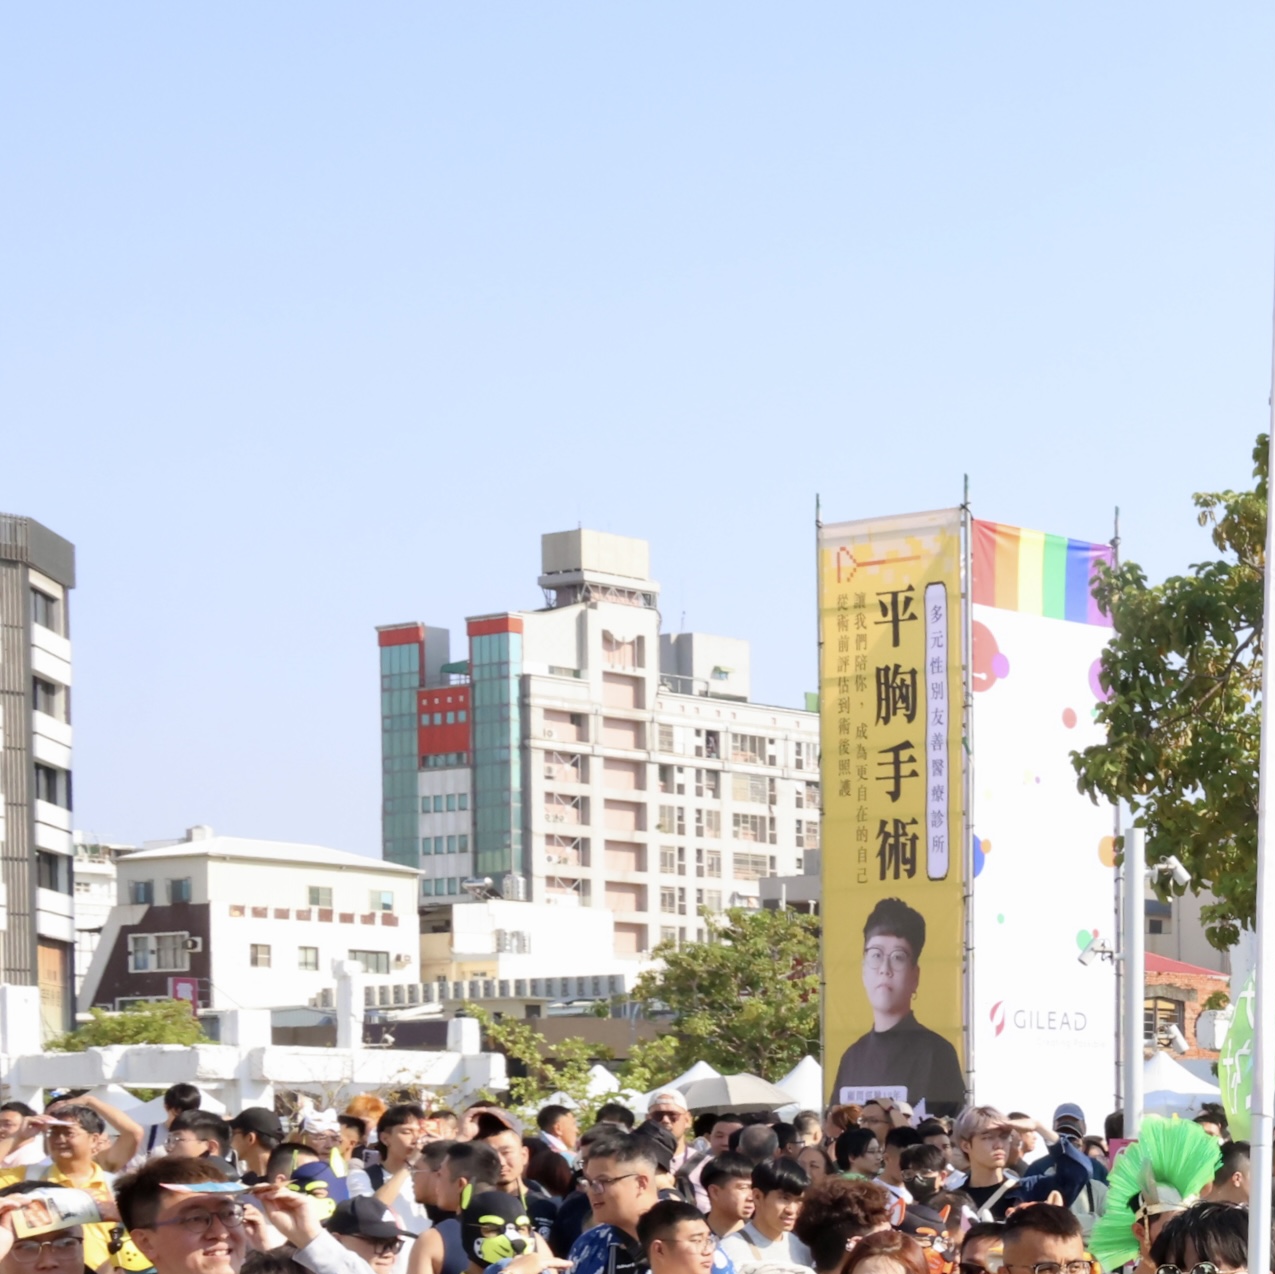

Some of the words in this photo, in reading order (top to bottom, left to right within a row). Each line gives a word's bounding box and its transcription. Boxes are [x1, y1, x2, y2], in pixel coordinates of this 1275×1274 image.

[873, 584, 920, 881] 平胸手術
[929, 604, 945, 854] 多元性別友善醫療診所
[1014, 1009, 1087, 1031] GILEAD
